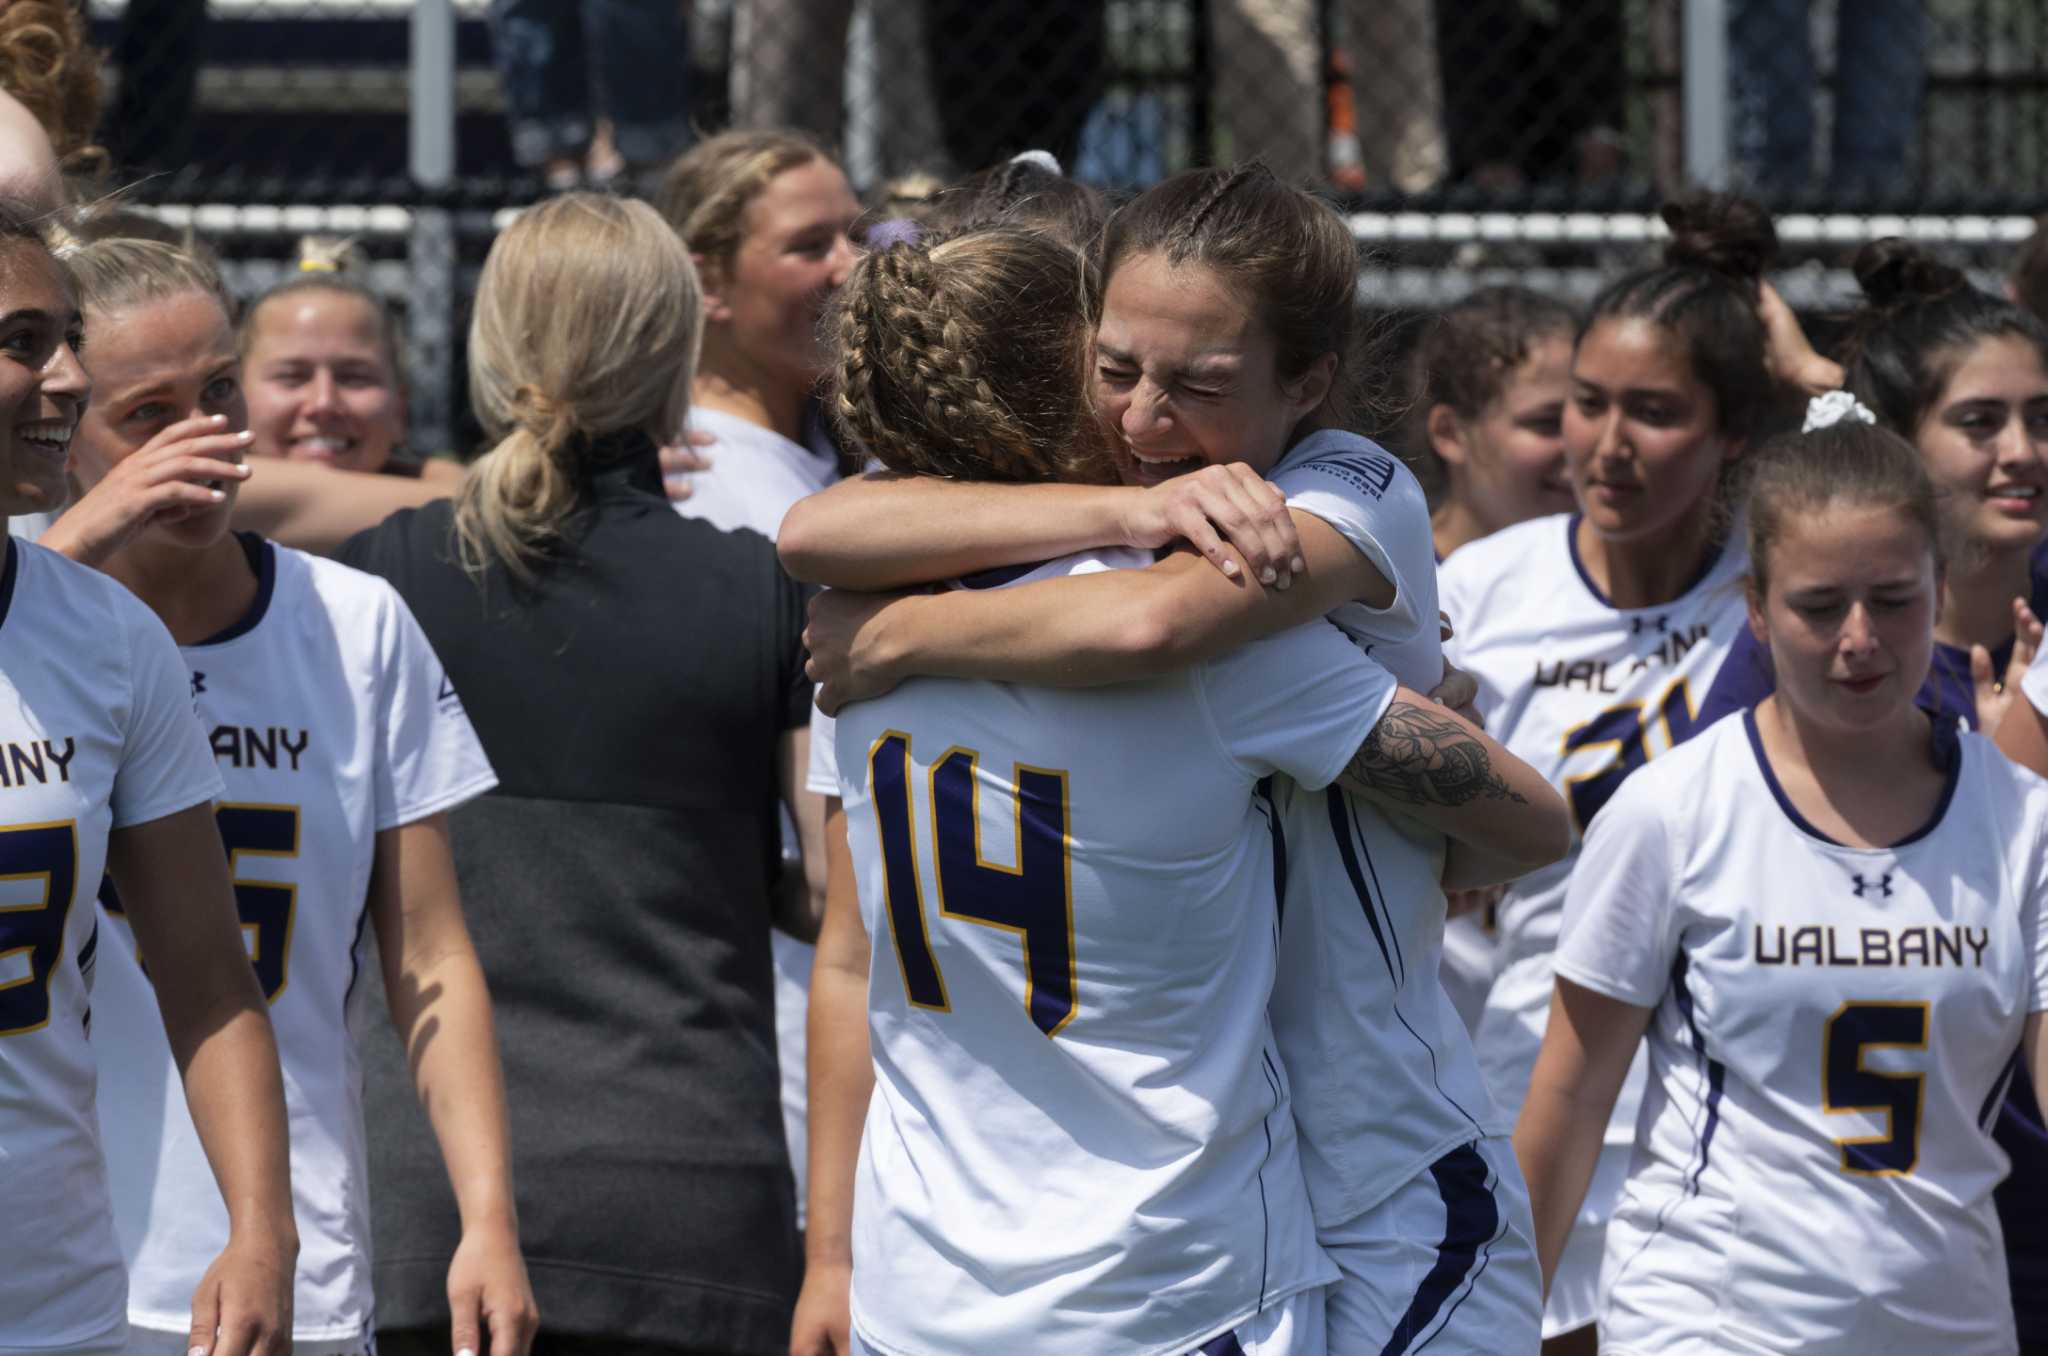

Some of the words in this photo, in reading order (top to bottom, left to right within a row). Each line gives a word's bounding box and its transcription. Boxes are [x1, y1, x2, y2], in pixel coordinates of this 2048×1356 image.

[868, 727, 1078, 1040] 14
[1754, 924, 1989, 967] UALBANY
[1821, 1000, 1931, 1180] 5
